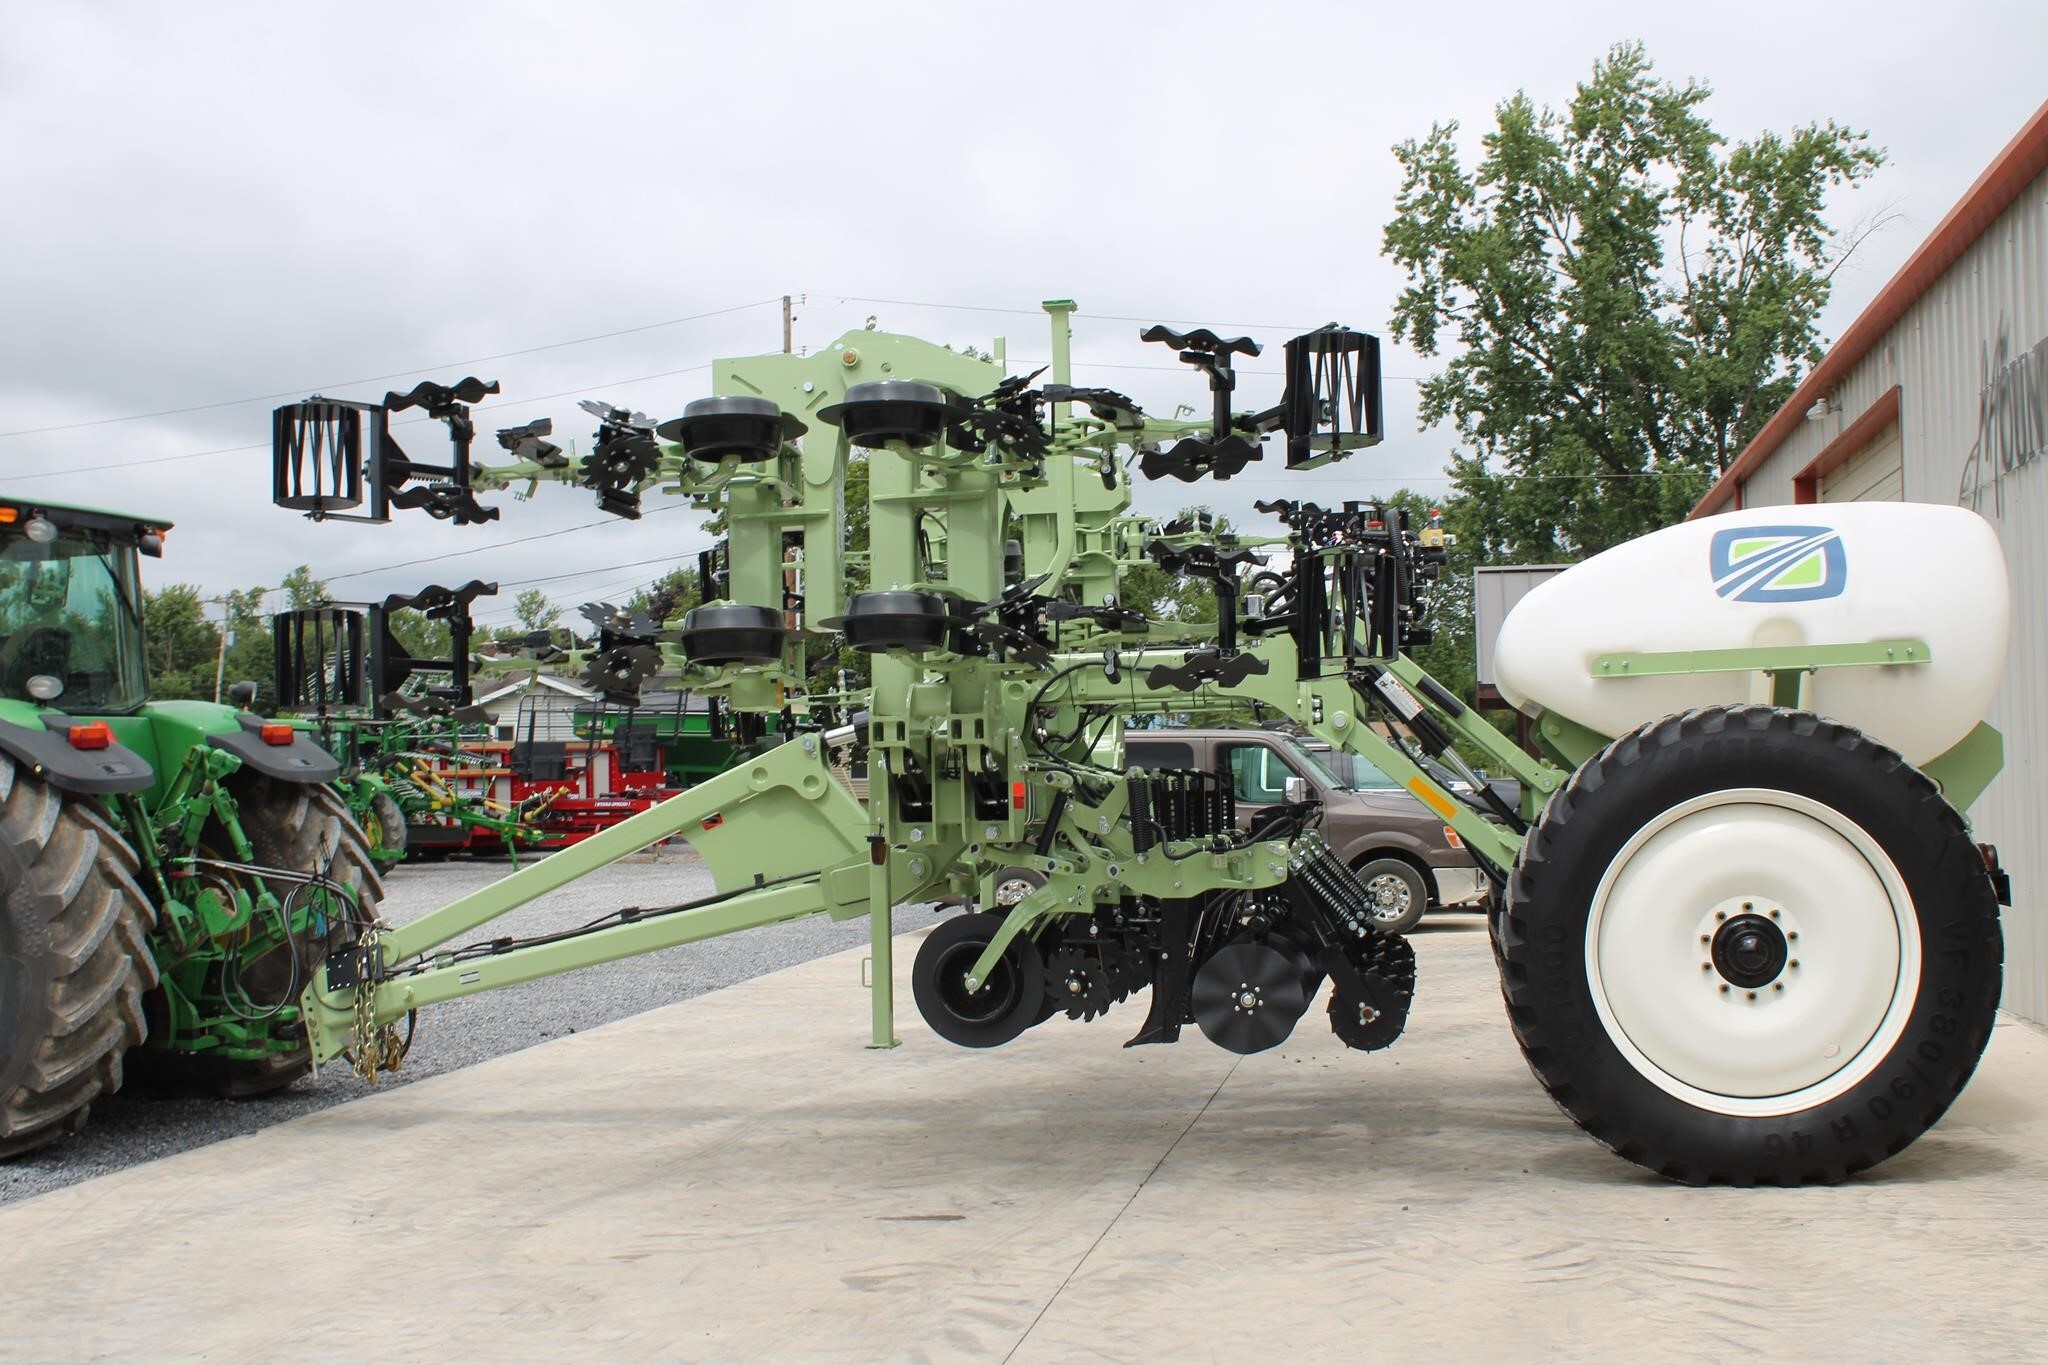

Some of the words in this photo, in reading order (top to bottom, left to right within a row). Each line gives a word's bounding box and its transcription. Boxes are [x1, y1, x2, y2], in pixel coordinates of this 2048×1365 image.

[1942, 920, 1969, 971] VF
[1867, 986, 1965, 1120] 380/90
[1763, 1131, 1814, 1158] 46
[1829, 1115, 1859, 1142] R
